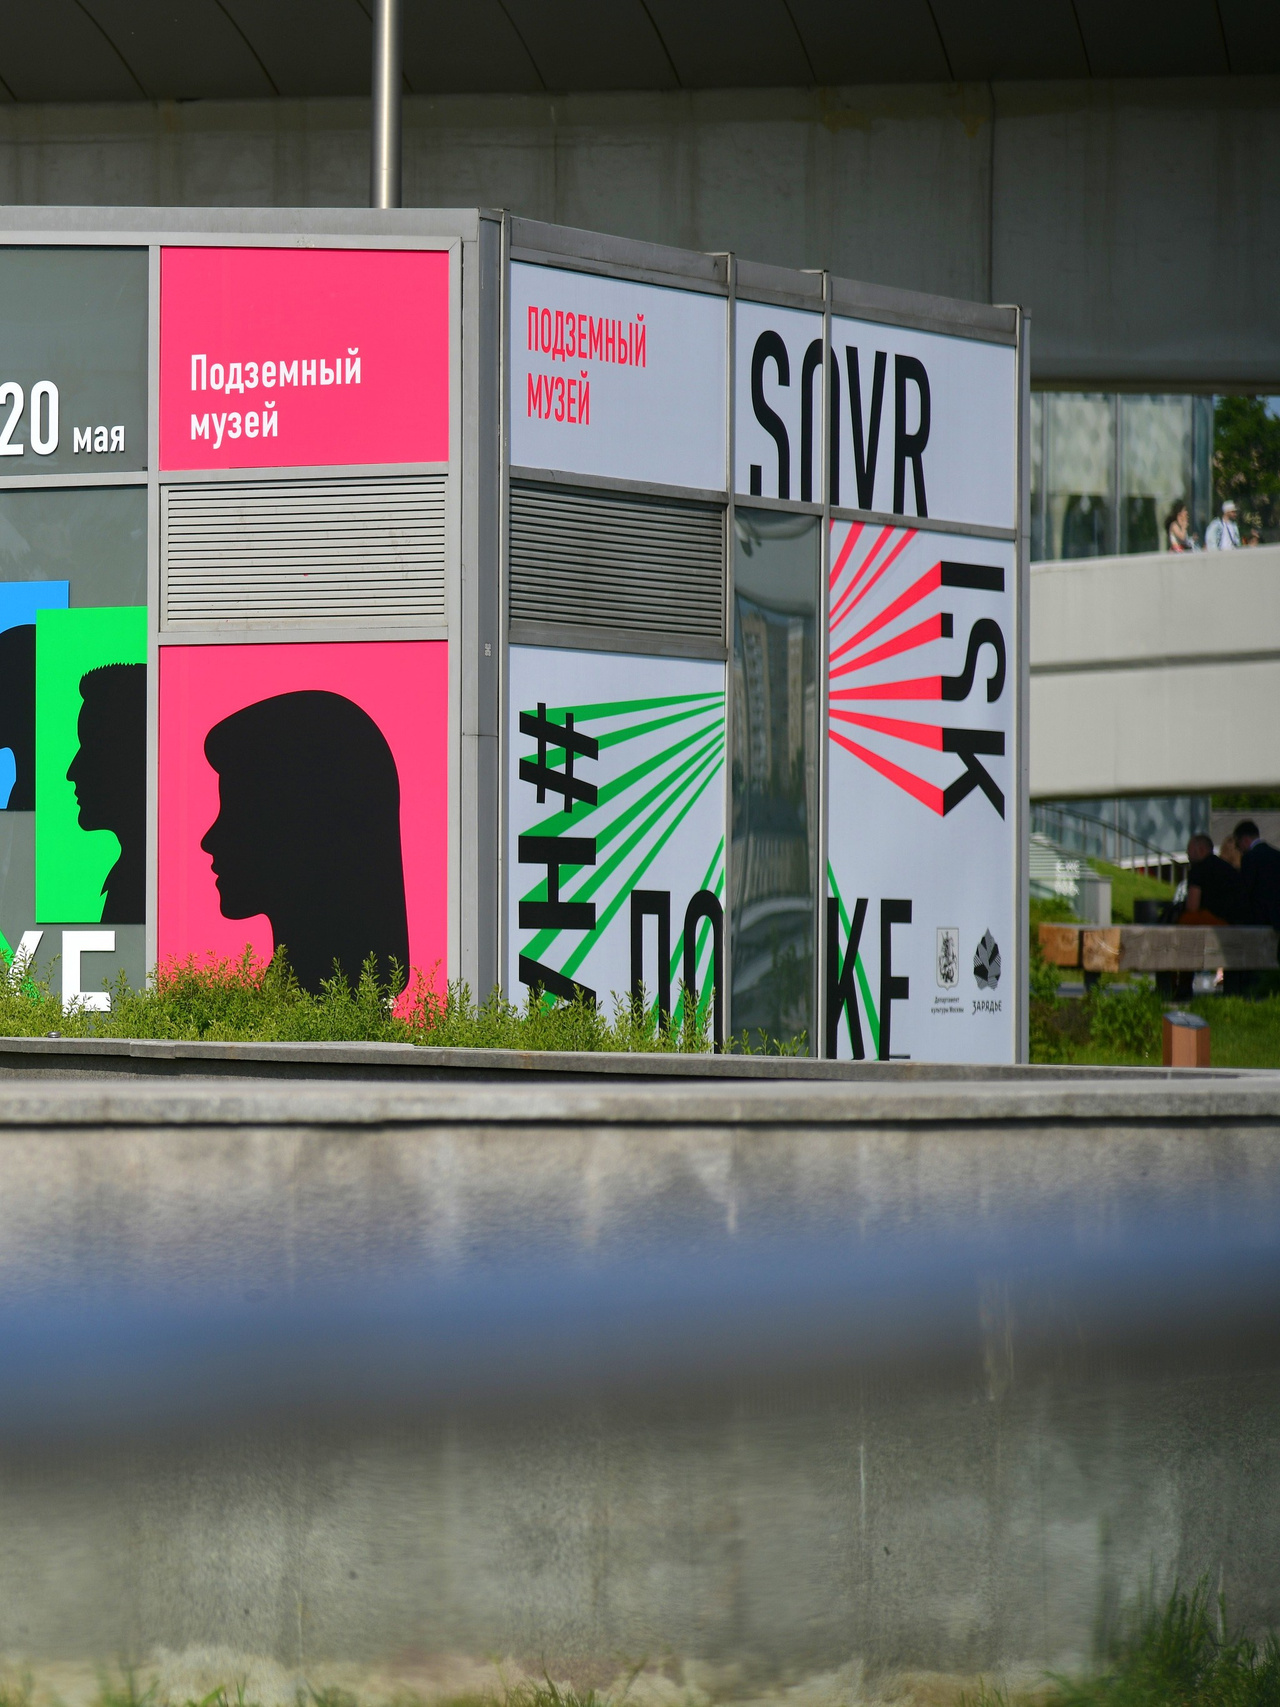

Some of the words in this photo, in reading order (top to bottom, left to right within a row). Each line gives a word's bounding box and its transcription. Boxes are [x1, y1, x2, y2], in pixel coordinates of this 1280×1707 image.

[527, 305, 647, 368] ПОДЗЕМНЫЙ
[190, 347, 362, 394] Подземный
[527, 370, 590, 425] МУЗЕЙ
[73, 425, 125, 453] мая
[190, 401, 279, 450] музей
